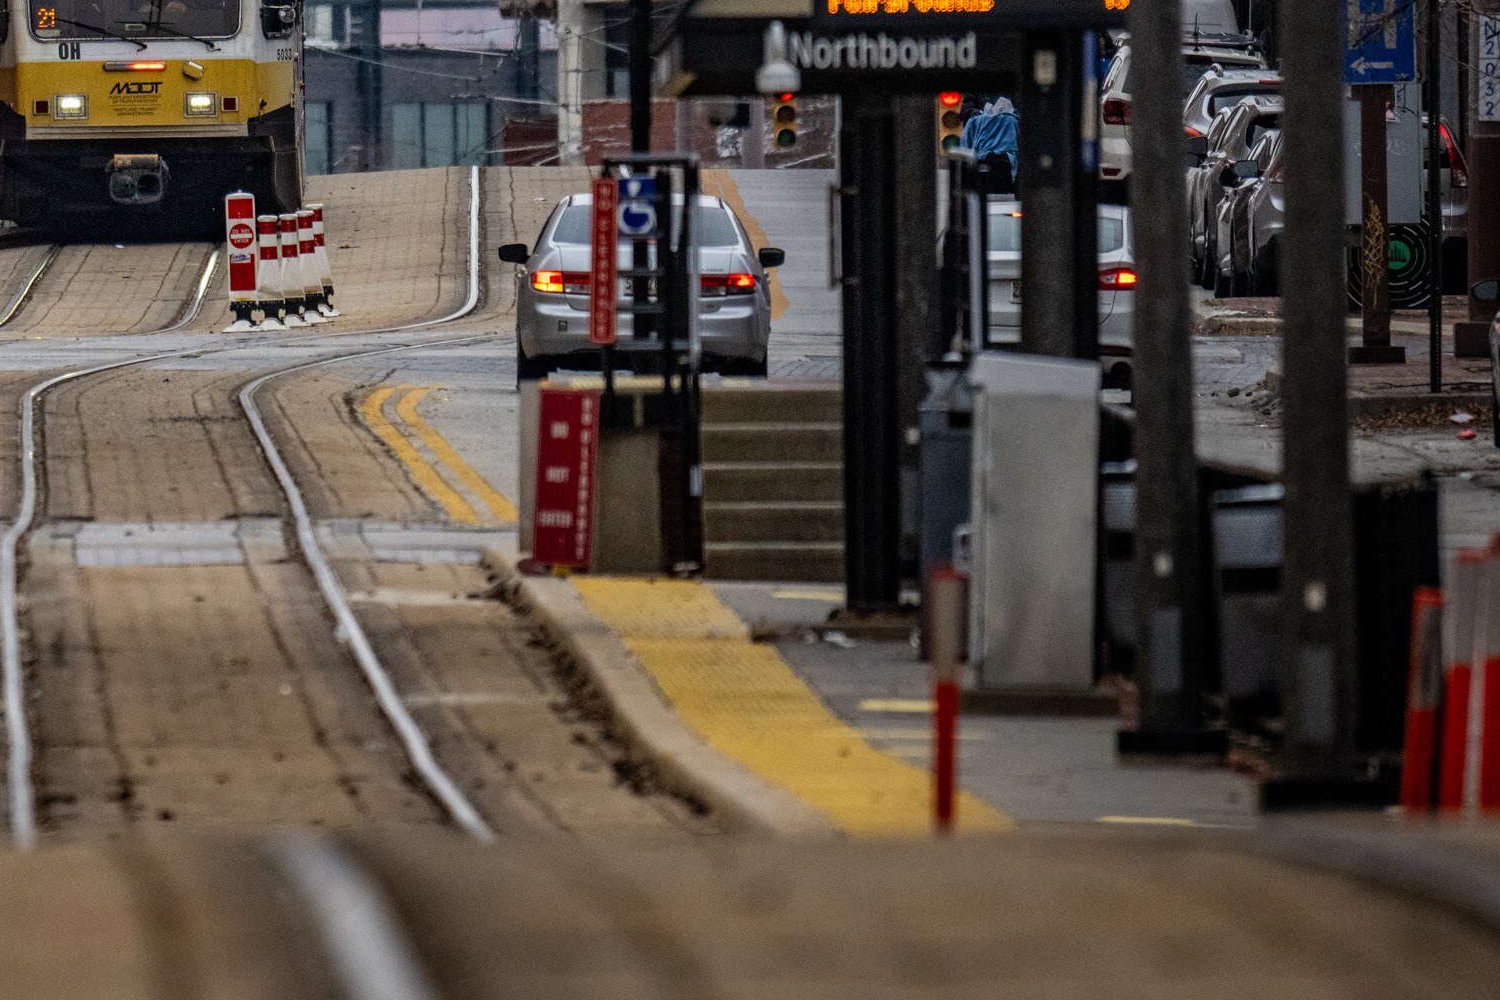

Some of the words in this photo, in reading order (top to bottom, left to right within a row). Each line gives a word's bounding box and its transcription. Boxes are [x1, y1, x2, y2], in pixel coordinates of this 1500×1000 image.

[37, 7, 56, 29] 21
[58, 42, 81, 61] OH
[276, 48, 293, 61] 5033
[789, 31, 977, 70] Northbound
[109, 82, 163, 94] MDOT
